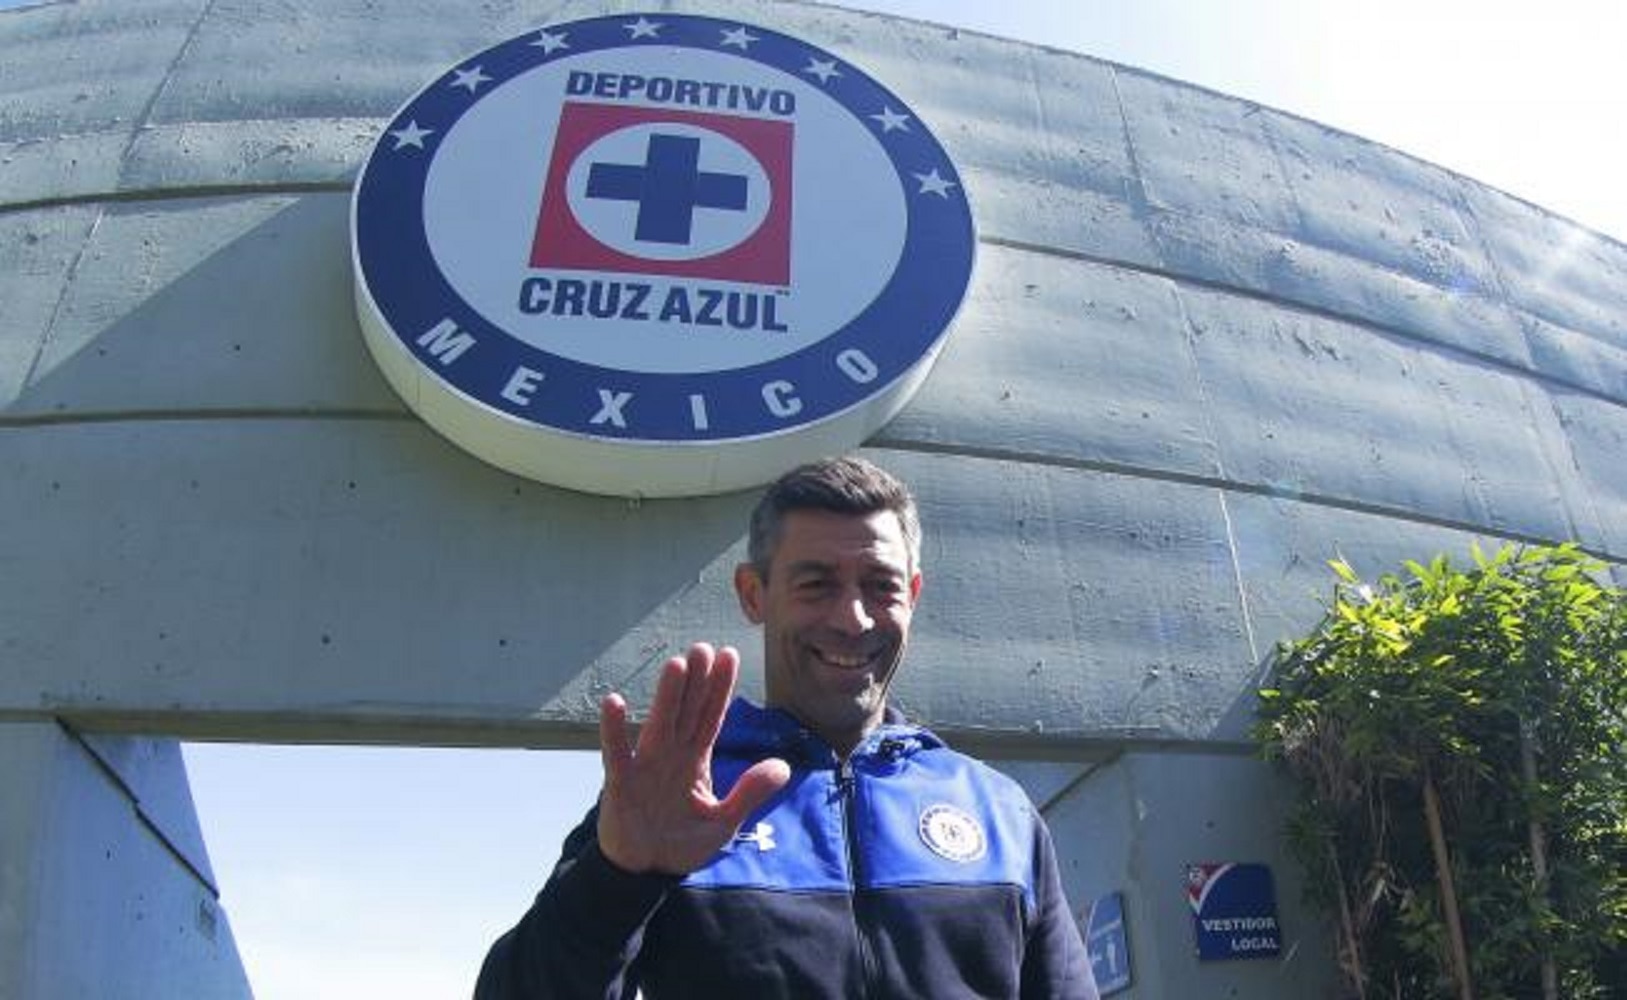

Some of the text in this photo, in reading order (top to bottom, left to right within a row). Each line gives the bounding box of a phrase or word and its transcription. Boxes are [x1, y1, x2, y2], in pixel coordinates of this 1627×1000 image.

[566, 69, 796, 116] DEPORTIVO
[518, 276, 789, 333] CRUZ AZUL
[415, 317, 880, 432] MEXICO
[1202, 916, 1277, 932] VESTIDOR
[1231, 936, 1280, 952] LOCAL
